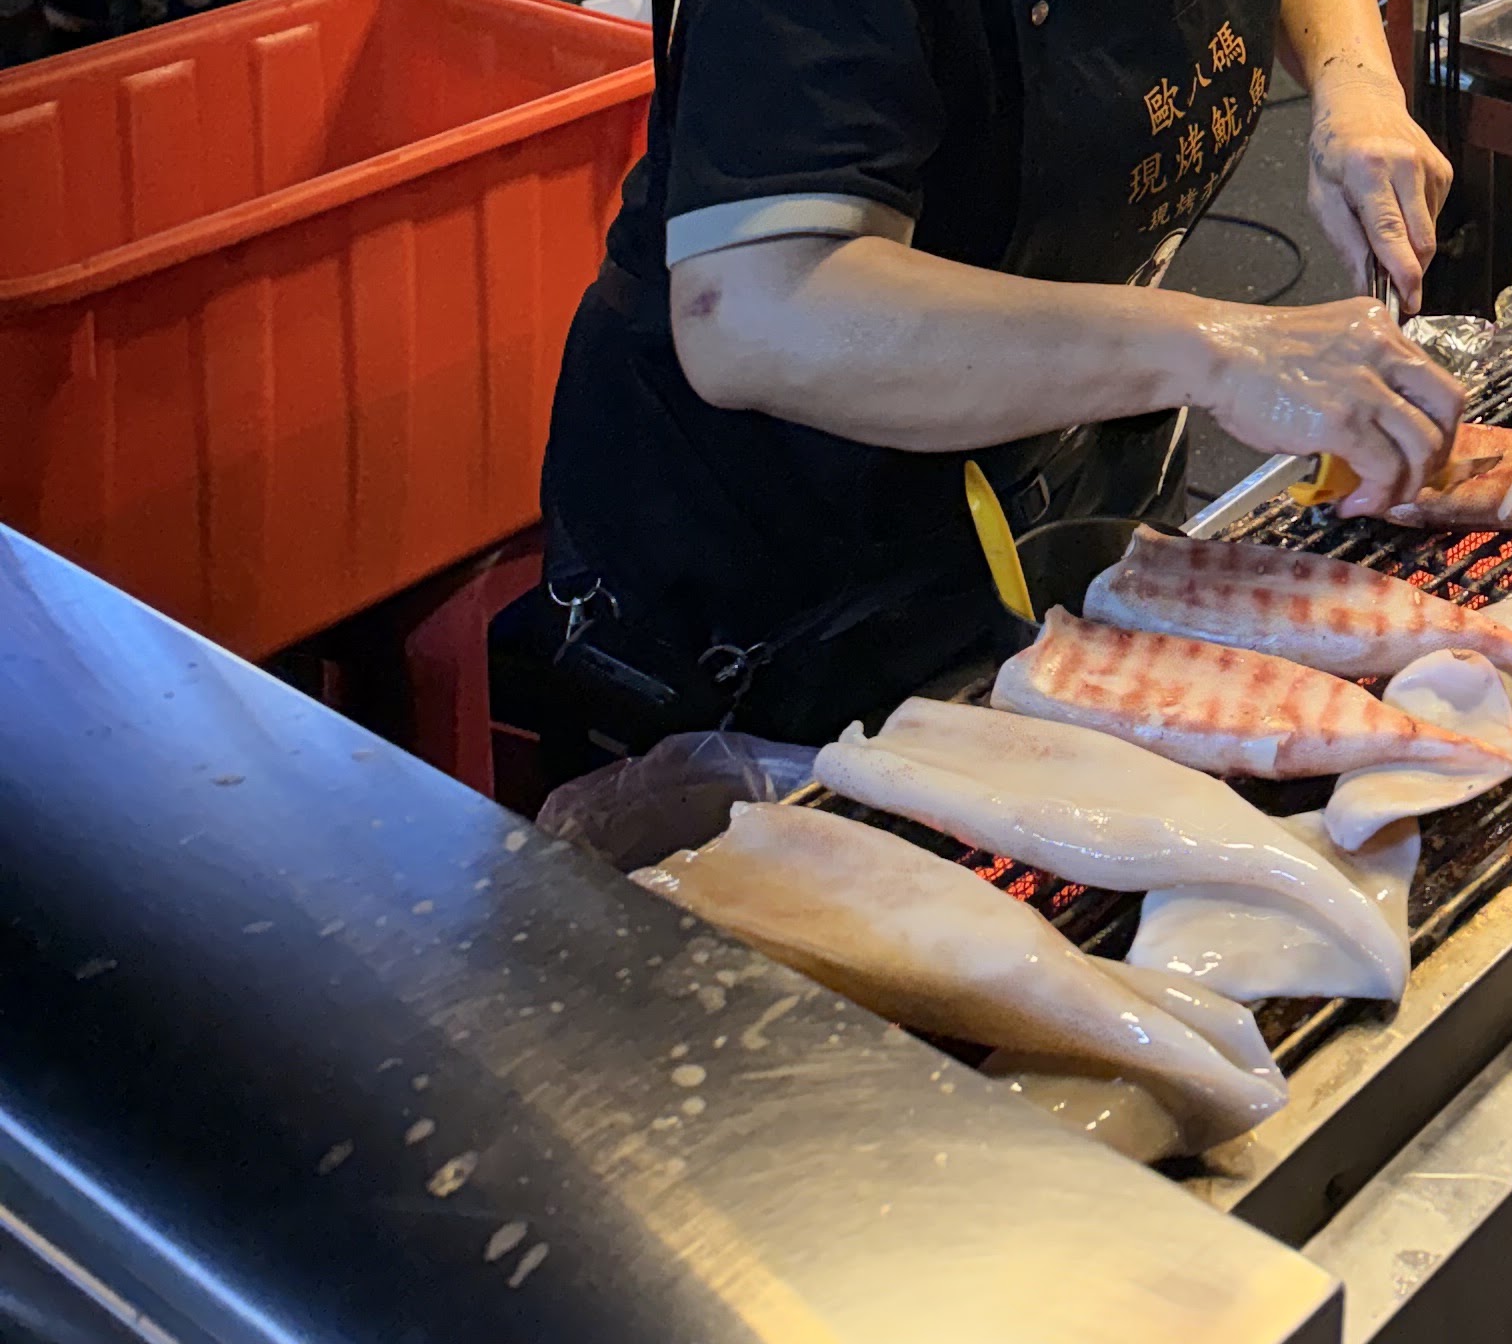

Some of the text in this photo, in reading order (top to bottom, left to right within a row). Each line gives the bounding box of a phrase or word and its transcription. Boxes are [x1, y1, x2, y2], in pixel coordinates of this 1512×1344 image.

[1127, 66, 1269, 205] 現烤魷魚
[1143, 20, 1247, 136] 歐八碼
